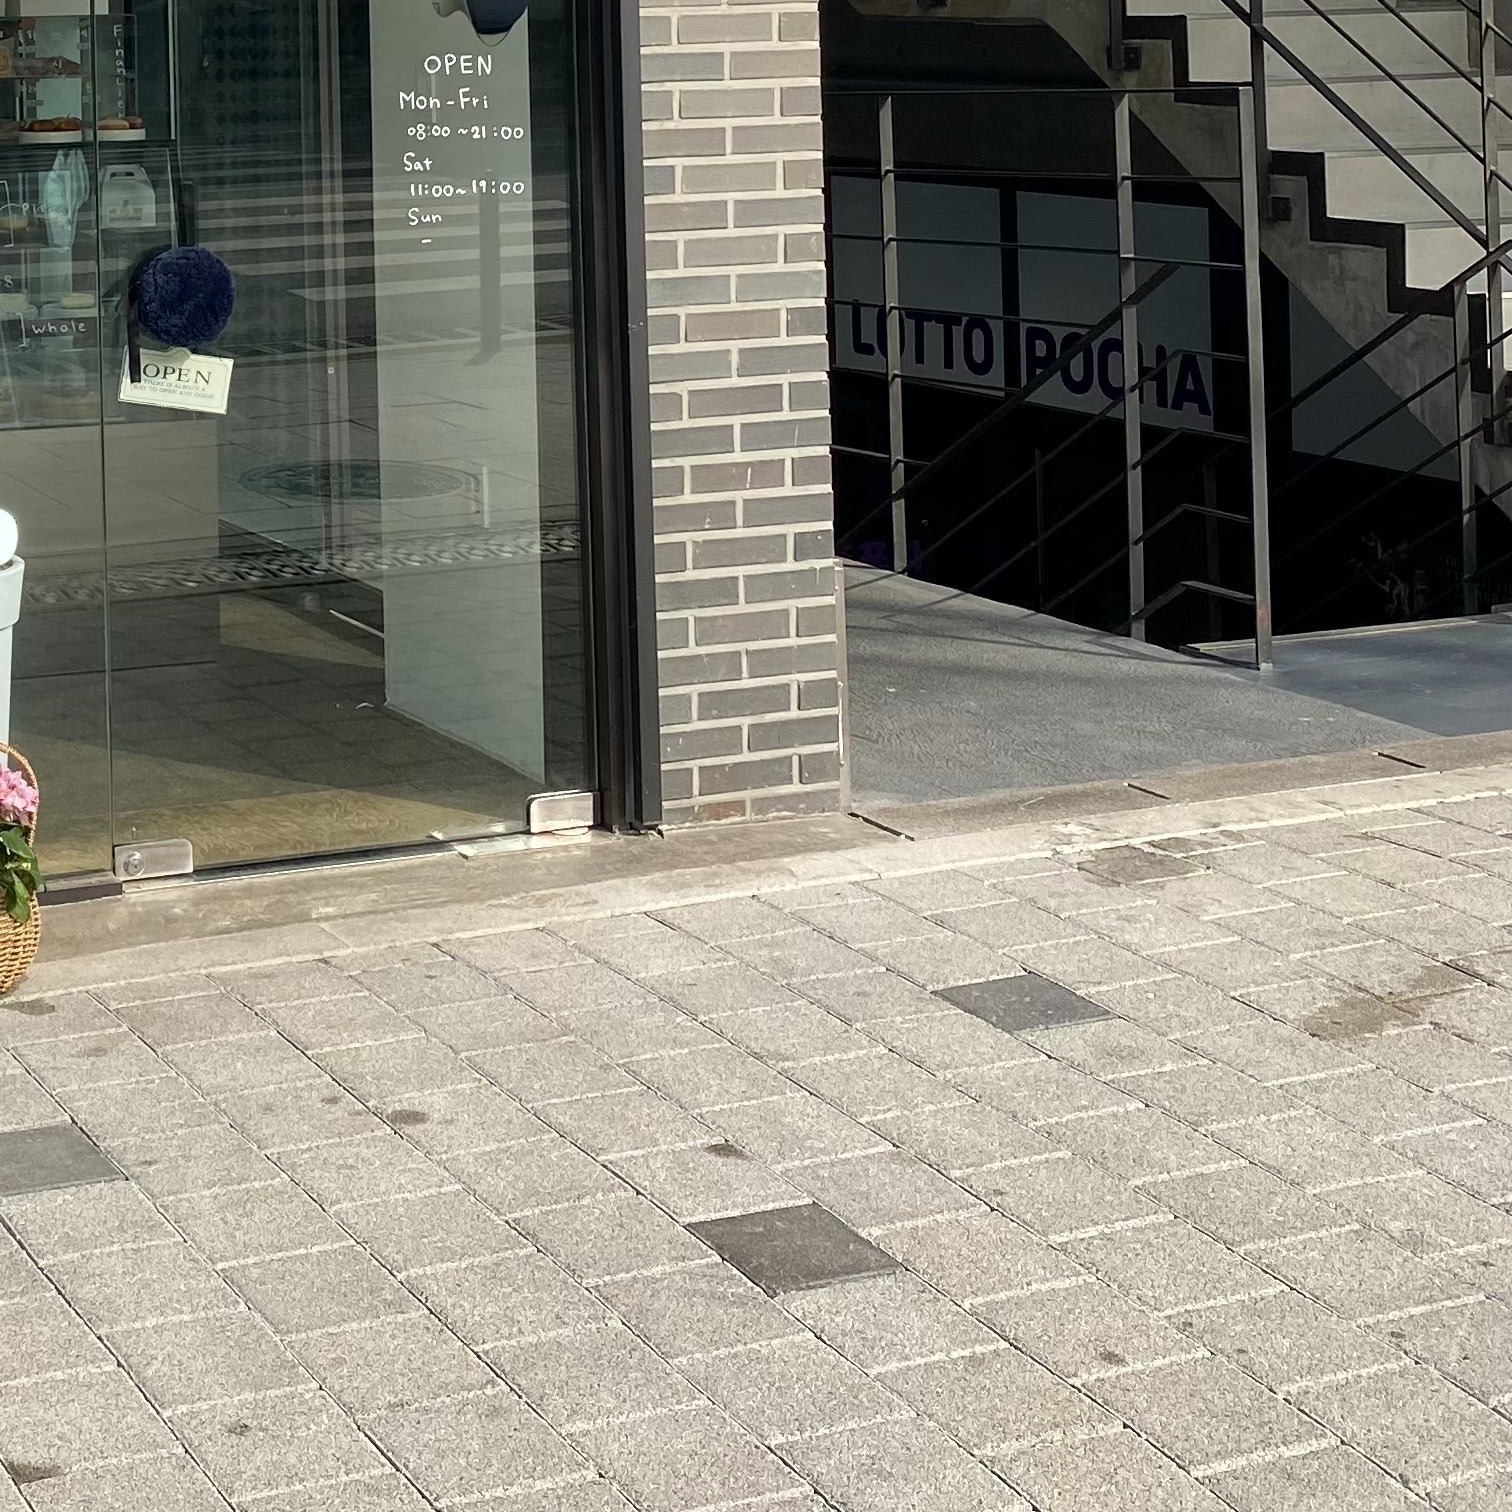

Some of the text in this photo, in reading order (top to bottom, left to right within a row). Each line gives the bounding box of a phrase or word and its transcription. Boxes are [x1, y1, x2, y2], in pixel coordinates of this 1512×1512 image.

[423, 53, 492, 76] OPEN
[403, 152, 433, 171] Sat
[407, 208, 443, 225] Sun
[32, 319, 87, 334] whole
[850, 299, 1213, 418] LOTTO POCHA
[142, 363, 212, 386] OPEN
